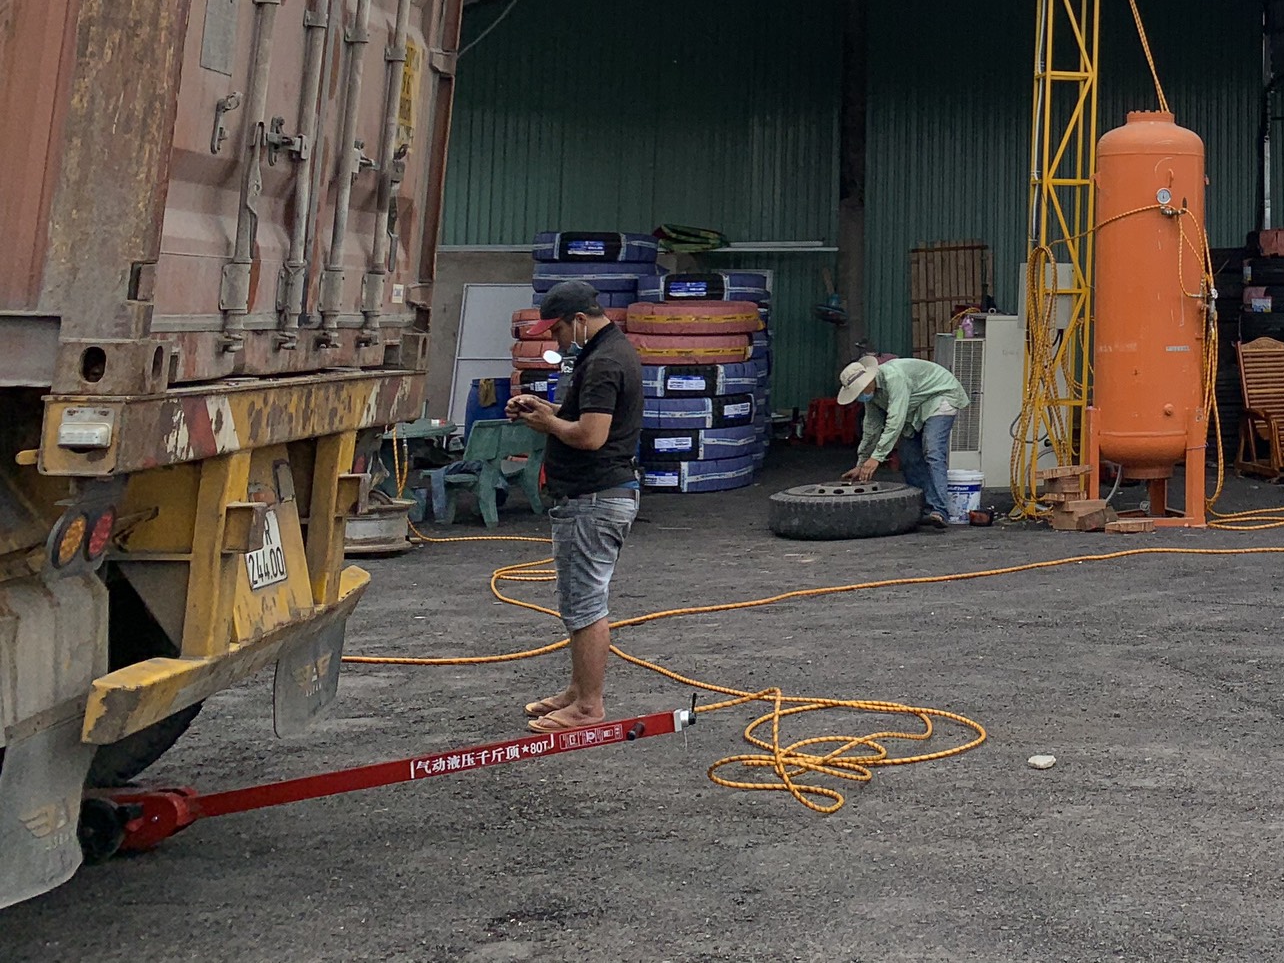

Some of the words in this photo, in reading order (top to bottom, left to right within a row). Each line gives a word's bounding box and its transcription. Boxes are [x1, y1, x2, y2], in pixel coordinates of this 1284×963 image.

[249, 546, 286, 586] 244.00
[416, 744, 520, 775] 气动液压千斤顶
